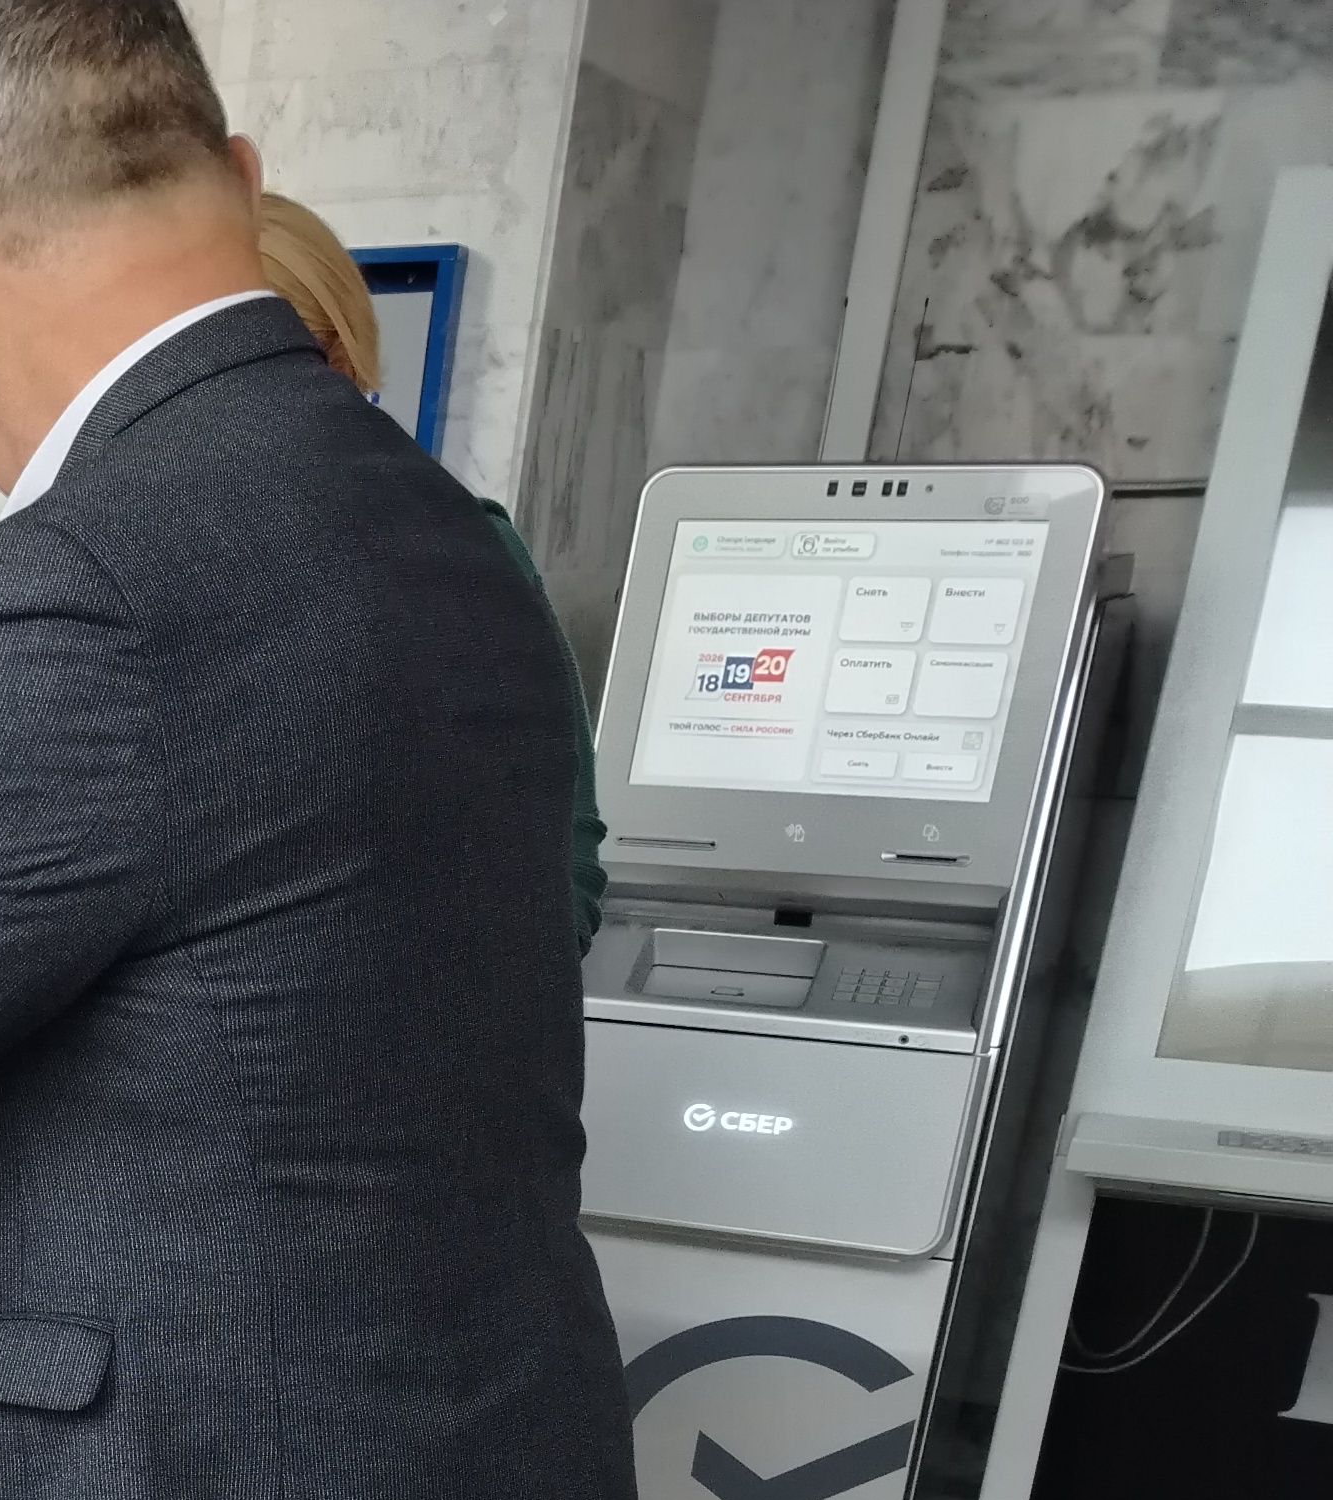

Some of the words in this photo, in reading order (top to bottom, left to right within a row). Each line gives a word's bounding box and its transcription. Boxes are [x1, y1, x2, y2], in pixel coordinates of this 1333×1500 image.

[855, 587, 888, 597] Снять
[945, 588, 986, 598] Внести
[693, 612, 741, 623] ВЫБОРЫ
[744, 613, 811, 623] ДЕПУТАТОВ
[688, 625, 780, 636] ГОСУДАРСТВЕННОЙ
[781, 628, 811, 637] ДУМЫ
[698, 653, 724, 662] 2026
[840, 658, 892, 669] Оплатить
[697, 674, 719, 692] 18
[726, 664, 750, 684] 19
[755, 655, 786, 675] 20
[724, 692, 782, 703] СЕНТЯБРЯ
[693, 723, 721, 732] ГОЛОС
[730, 724, 753, 733] СИЛА
[827, 729, 854, 739] Через
[903, 731, 939, 741] Онлайн
[720, 1111, 792, 1135] СБЕР
